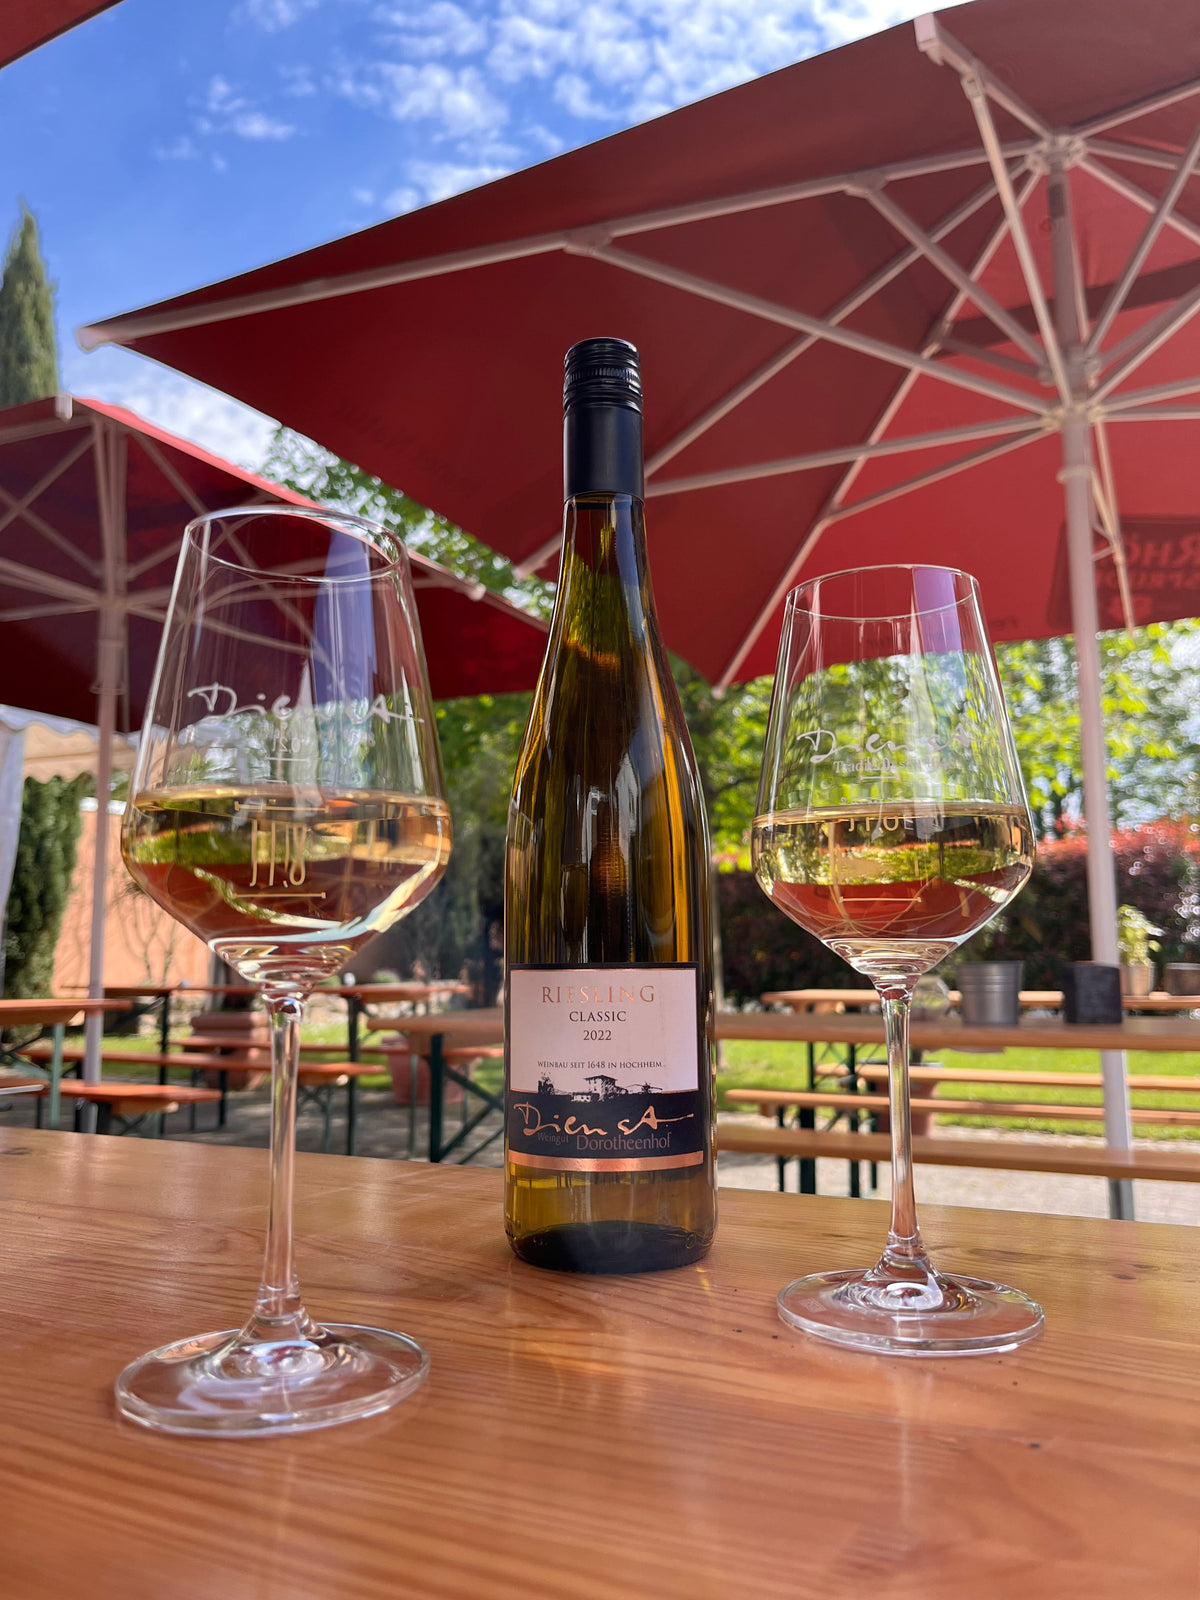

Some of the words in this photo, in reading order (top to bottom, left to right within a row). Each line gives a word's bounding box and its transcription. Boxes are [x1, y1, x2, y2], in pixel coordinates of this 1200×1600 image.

[541, 985, 655, 1004] RIESLING
[569, 1011, 627, 1022] CLASSIC
[583, 1030, 612, 1041] 2022
[537, 1061, 568, 1069] WEINBAU
[570, 1061, 586, 1069] SEIT
[587, 1060, 606, 1069] 1648
[607, 1061, 617, 1069] IN
[537, 1132, 569, 1145] Weingut
[576, 1132, 672, 1151] Dorotheenhof
